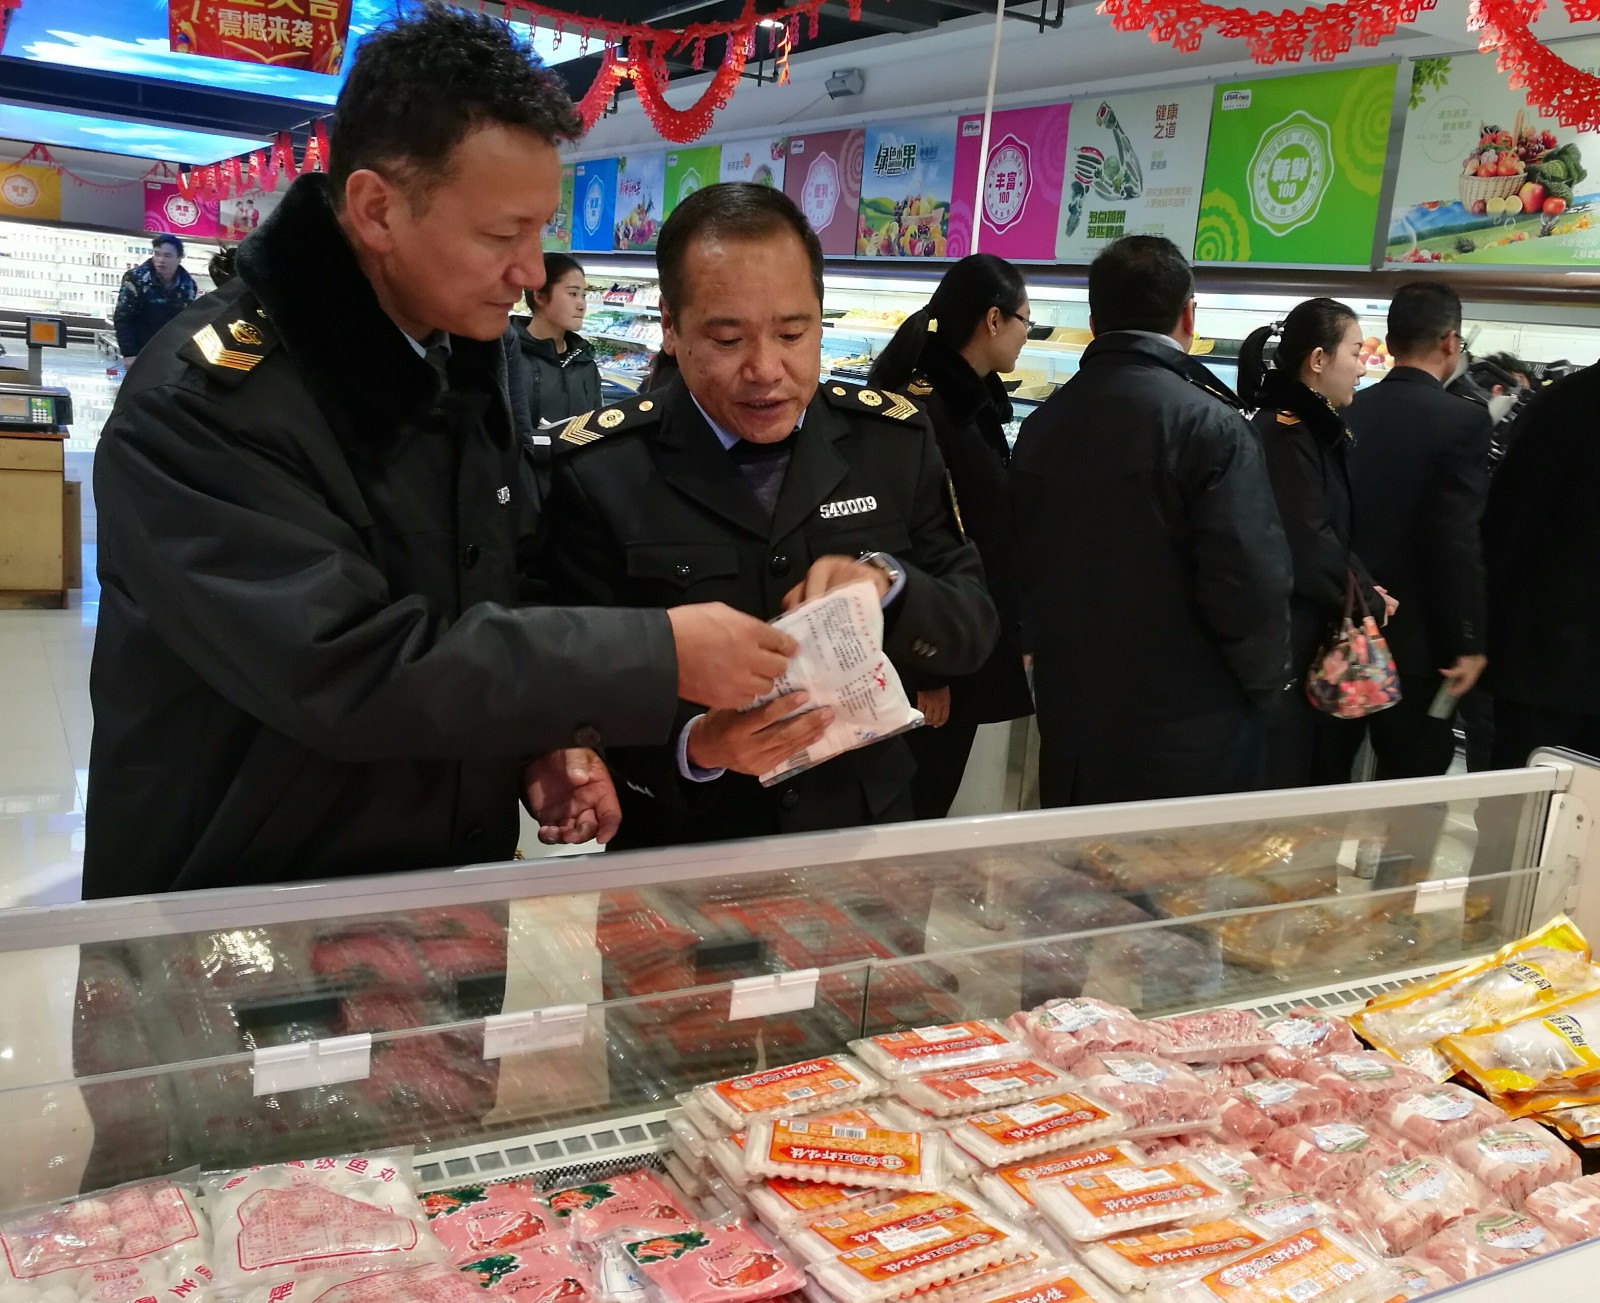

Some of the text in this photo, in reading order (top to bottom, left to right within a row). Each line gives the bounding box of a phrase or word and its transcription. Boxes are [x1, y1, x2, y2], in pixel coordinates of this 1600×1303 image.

[218, 8, 313, 49] 震撼来袭
[1156, 103, 1179, 121] 健康
[1154, 122, 1177, 139] 之道
[1270, 156, 1310, 182] 新鲜
[995, 171, 1018, 191] 丰富
[1278, 182, 1297, 199] 100
[998, 191, 1010, 204] 100
[820, 495, 878, 519] 540009
